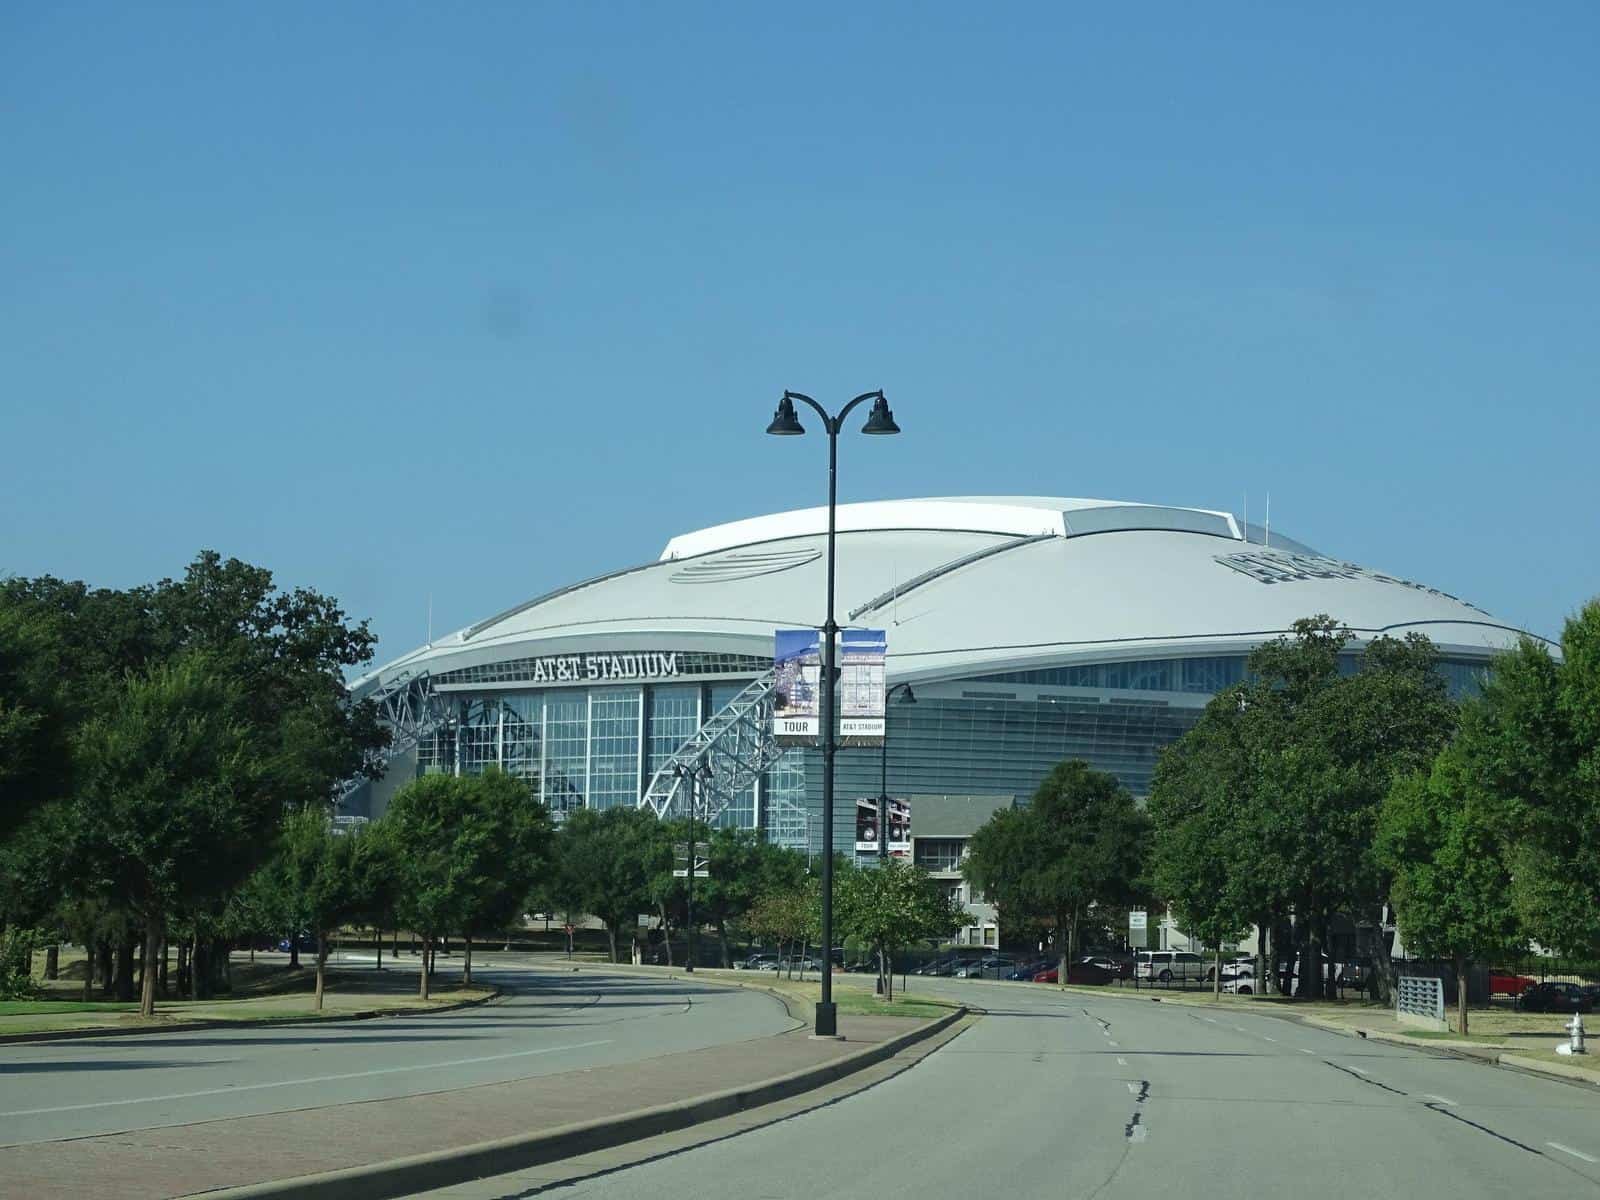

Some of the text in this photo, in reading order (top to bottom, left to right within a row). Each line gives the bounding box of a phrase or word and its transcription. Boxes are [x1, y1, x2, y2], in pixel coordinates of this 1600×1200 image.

[534, 653, 679, 680] AT&T STADIUM
[784, 721, 808, 732] TOUR
